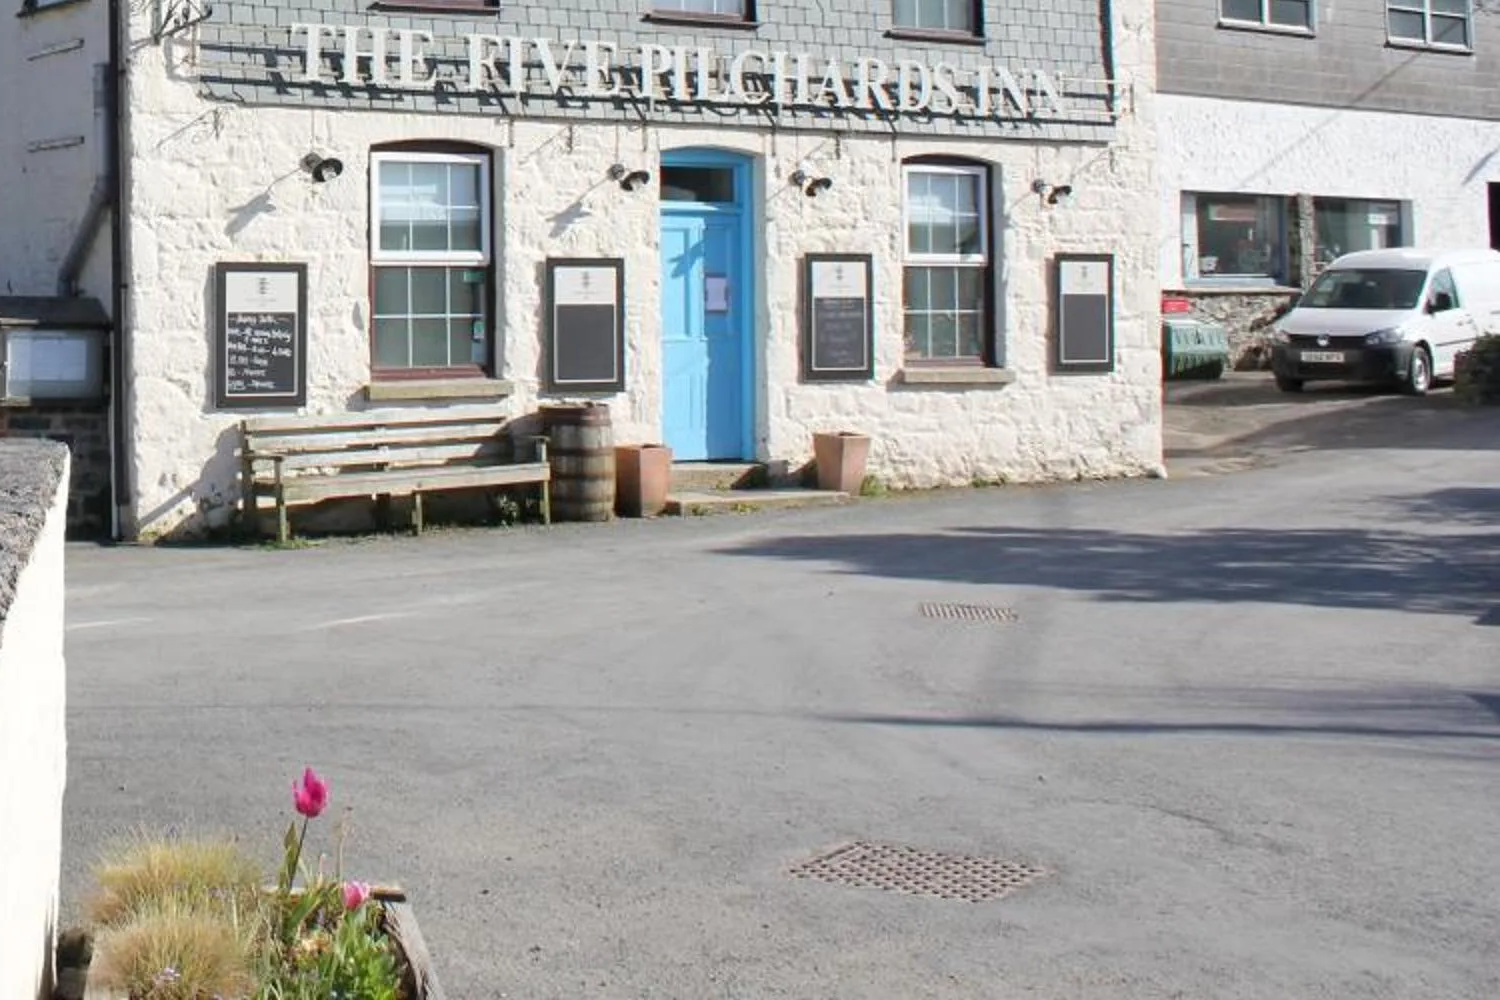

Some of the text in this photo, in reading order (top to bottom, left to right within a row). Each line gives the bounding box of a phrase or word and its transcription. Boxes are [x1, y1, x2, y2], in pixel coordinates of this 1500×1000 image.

[290, 22, 1067, 119] THE FIVE PILCHARDS INN
